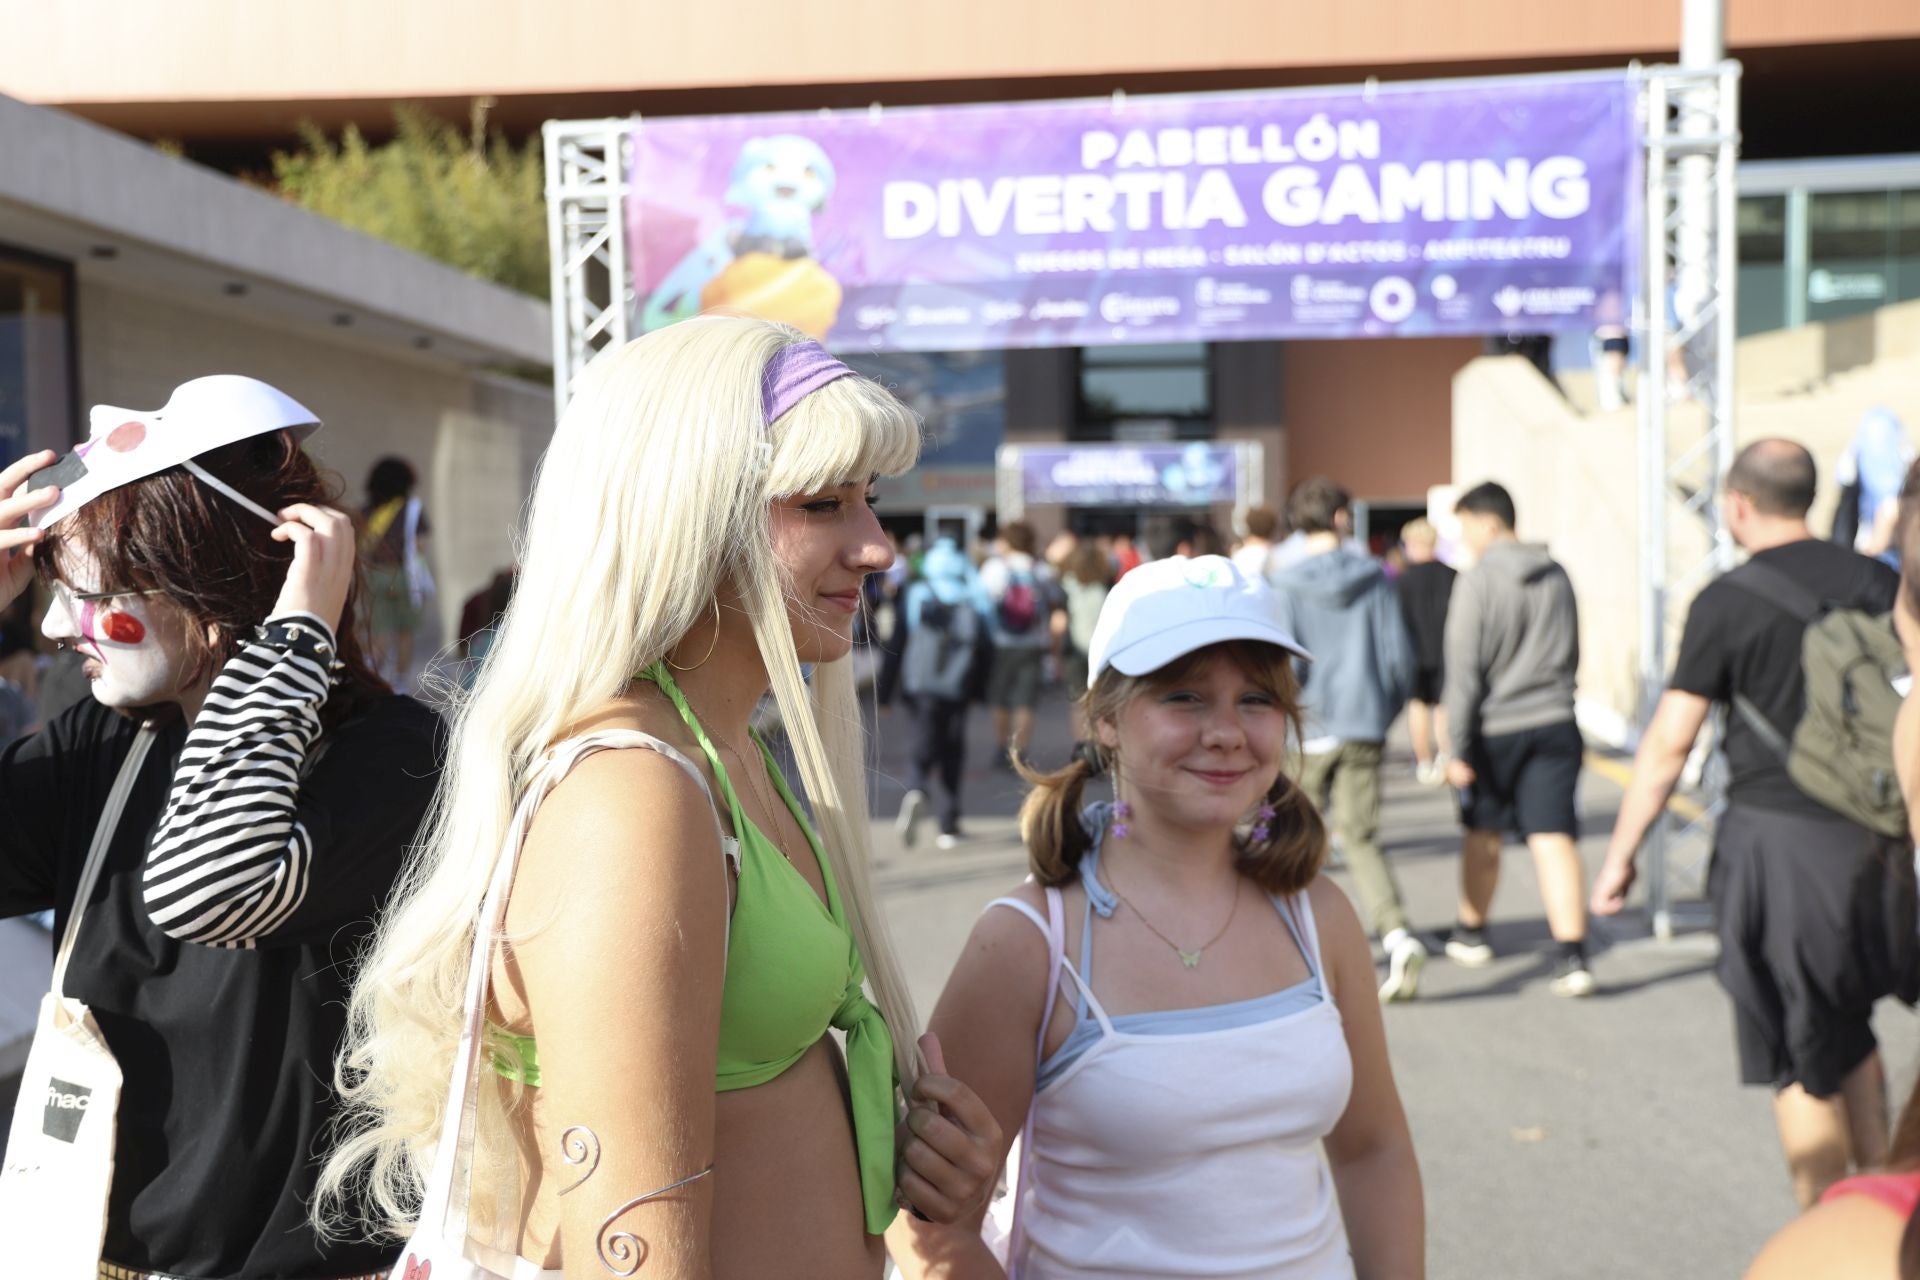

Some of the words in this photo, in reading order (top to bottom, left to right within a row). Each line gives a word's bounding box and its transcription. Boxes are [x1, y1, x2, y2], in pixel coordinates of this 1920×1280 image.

[1081, 114, 1380, 169] PABELLÓN
[883, 170, 1248, 239] DIVERTIA
[1261, 156, 1591, 226] GAMING
[1108, 248, 1140, 270] DE
